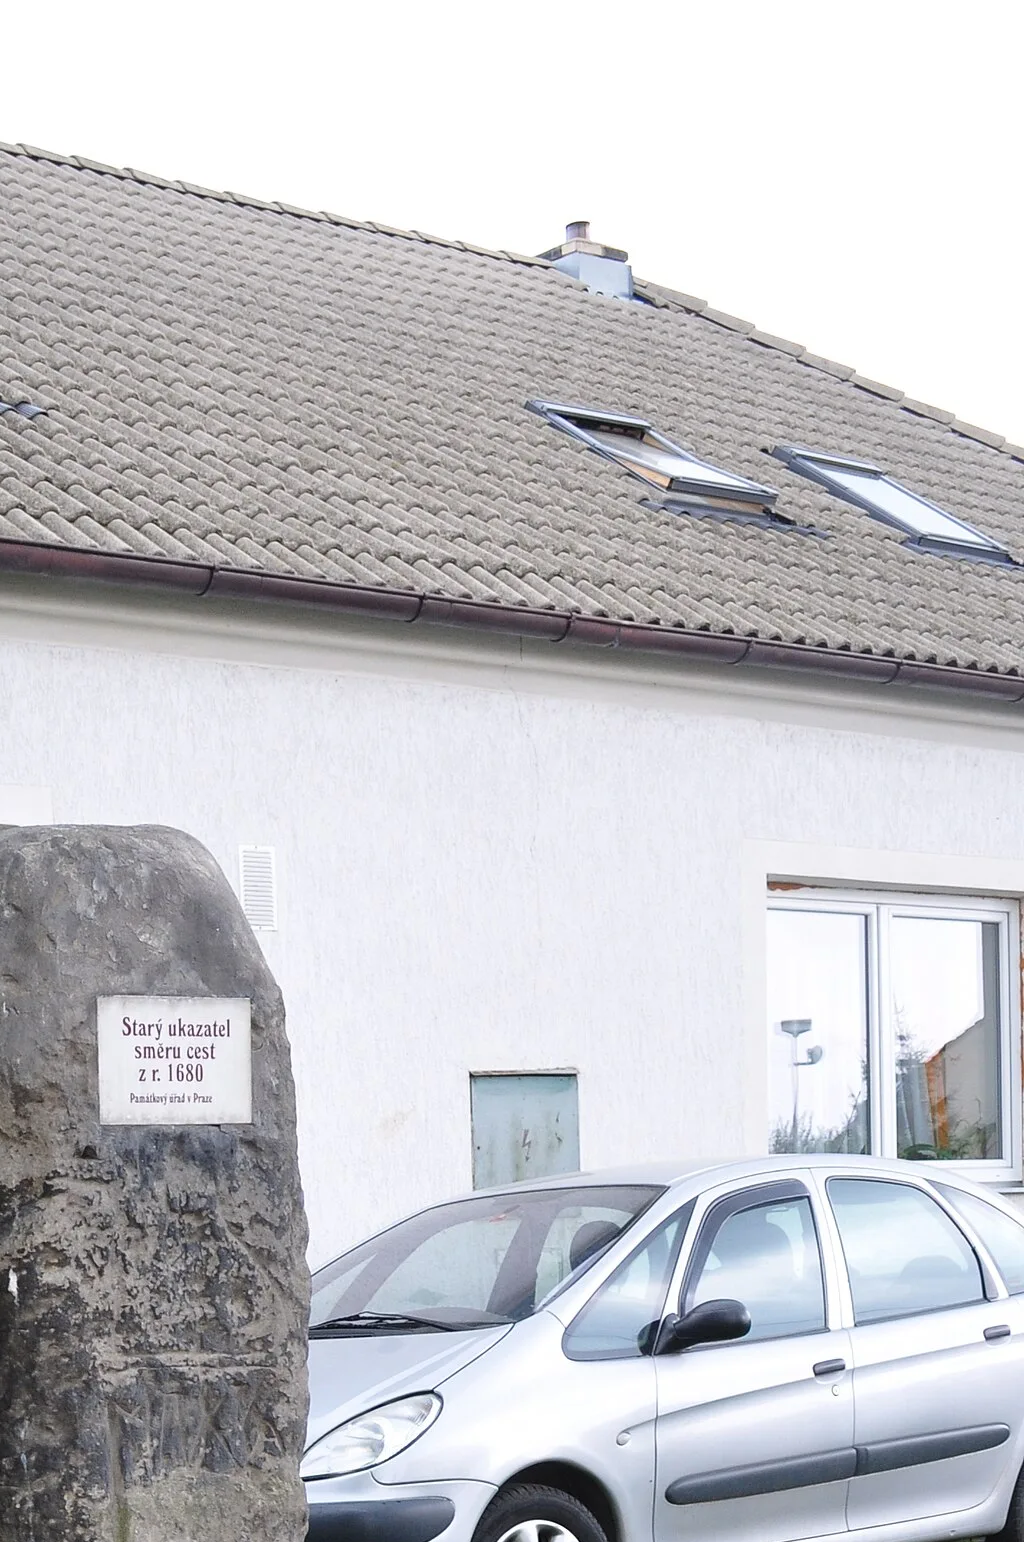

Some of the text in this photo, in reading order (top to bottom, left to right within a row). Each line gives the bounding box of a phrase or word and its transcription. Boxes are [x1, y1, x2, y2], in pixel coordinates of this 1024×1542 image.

[122, 1016, 231, 1040] Starý ukazatel
[135, 1043, 216, 1059] směru cest
[139, 1064, 204, 1082] z r. 1680
[129, 1092, 213, 1105] Památkový úřad v Praze
